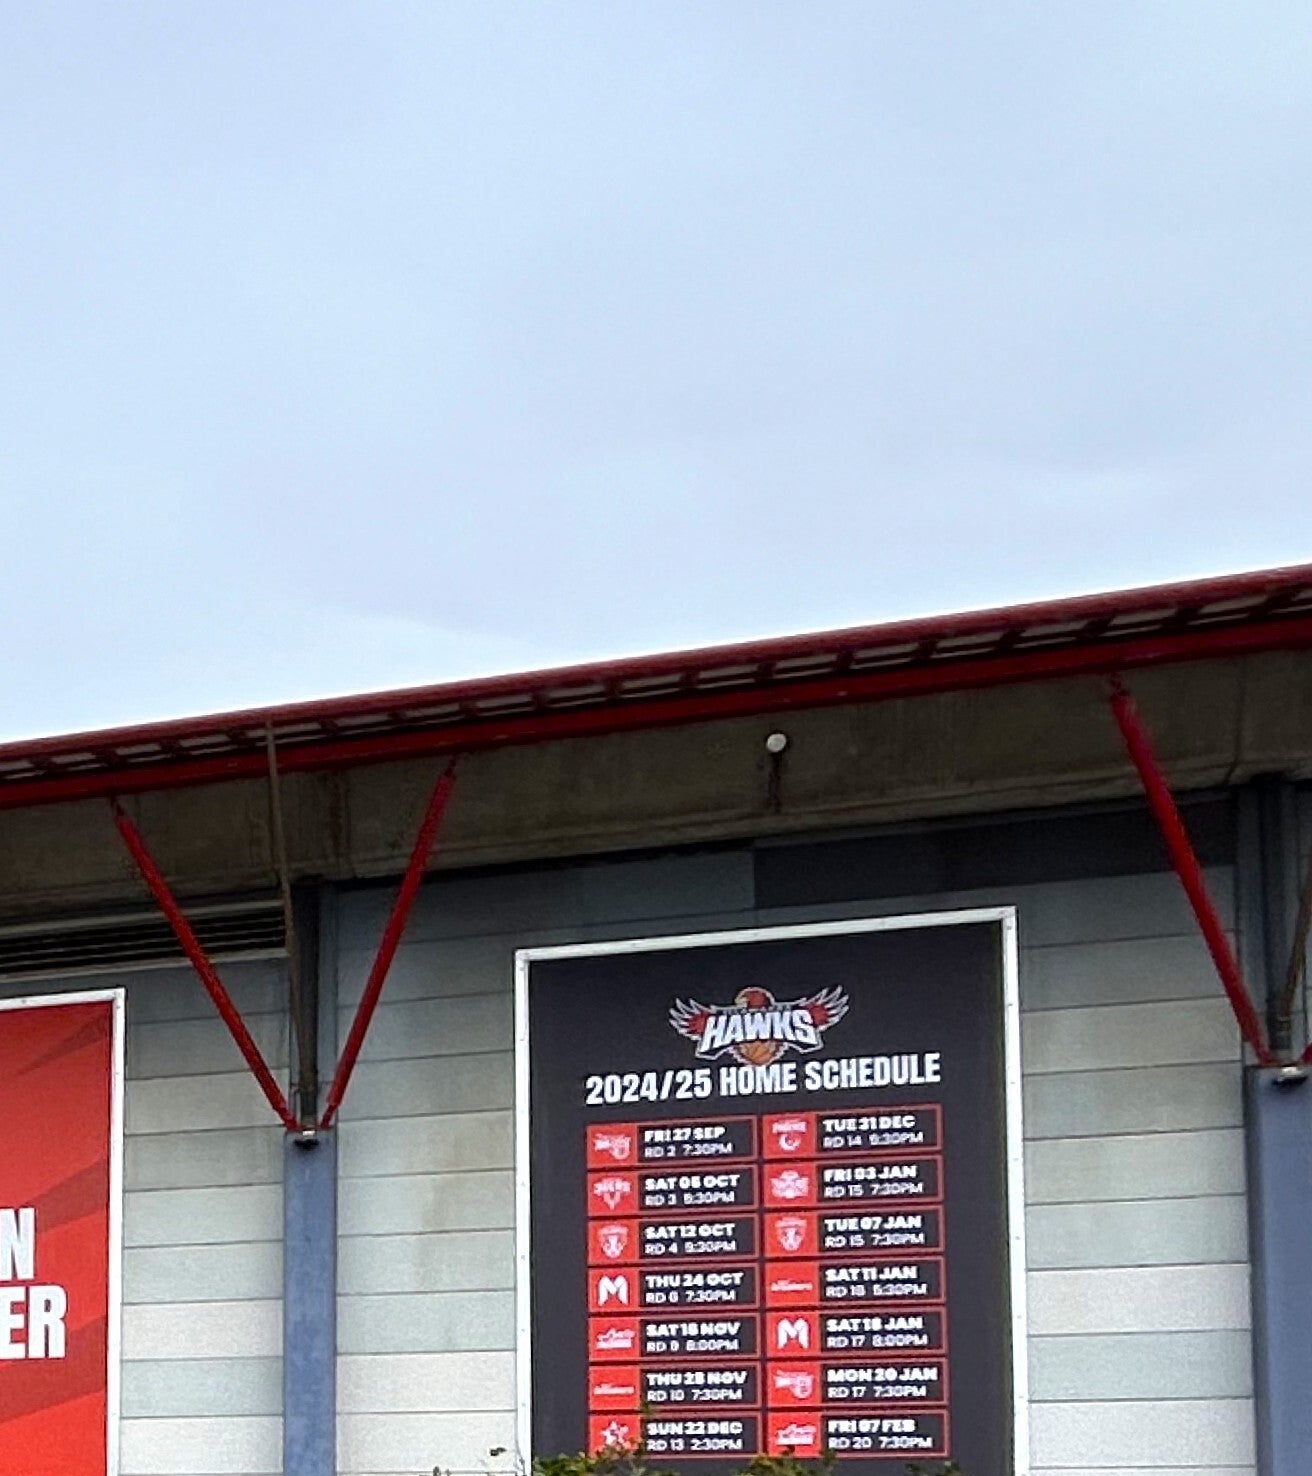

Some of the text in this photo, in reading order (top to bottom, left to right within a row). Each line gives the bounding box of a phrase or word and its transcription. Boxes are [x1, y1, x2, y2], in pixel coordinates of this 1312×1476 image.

[699, 1010, 818, 1053] HAWKS
[585, 1053, 941, 1105] 2024/25 HOME SCHEDULE
[879, 1115, 915, 1128] DEC
[694, 1127, 725, 1140] SEP
[824, 1169, 852, 1182] FRI
[878, 1165, 917, 1179] JAN
[645, 1178, 677, 1191] SAT
[703, 1174, 740, 1187] OCT
[884, 1215, 922, 1229] JAN
[645, 1226, 677, 1239] SAT
[699, 1223, 736, 1236] OCT
[645, 1272, 744, 1288] THU 24 OCT
[825, 1269, 862, 1282] SAT
[879, 1266, 918, 1279] JAN
[646, 1324, 679, 1337] SAT
[827, 1319, 861, 1332] SAT
[884, 1316, 923, 1330] JAN
[647, 1373, 682, 1386] THU
[827, 1369, 873, 1382] MON
[899, 1367, 938, 1380] JAN
[647, 1422, 683, 1435] SUN
[707, 1421, 743, 1434] DEC
